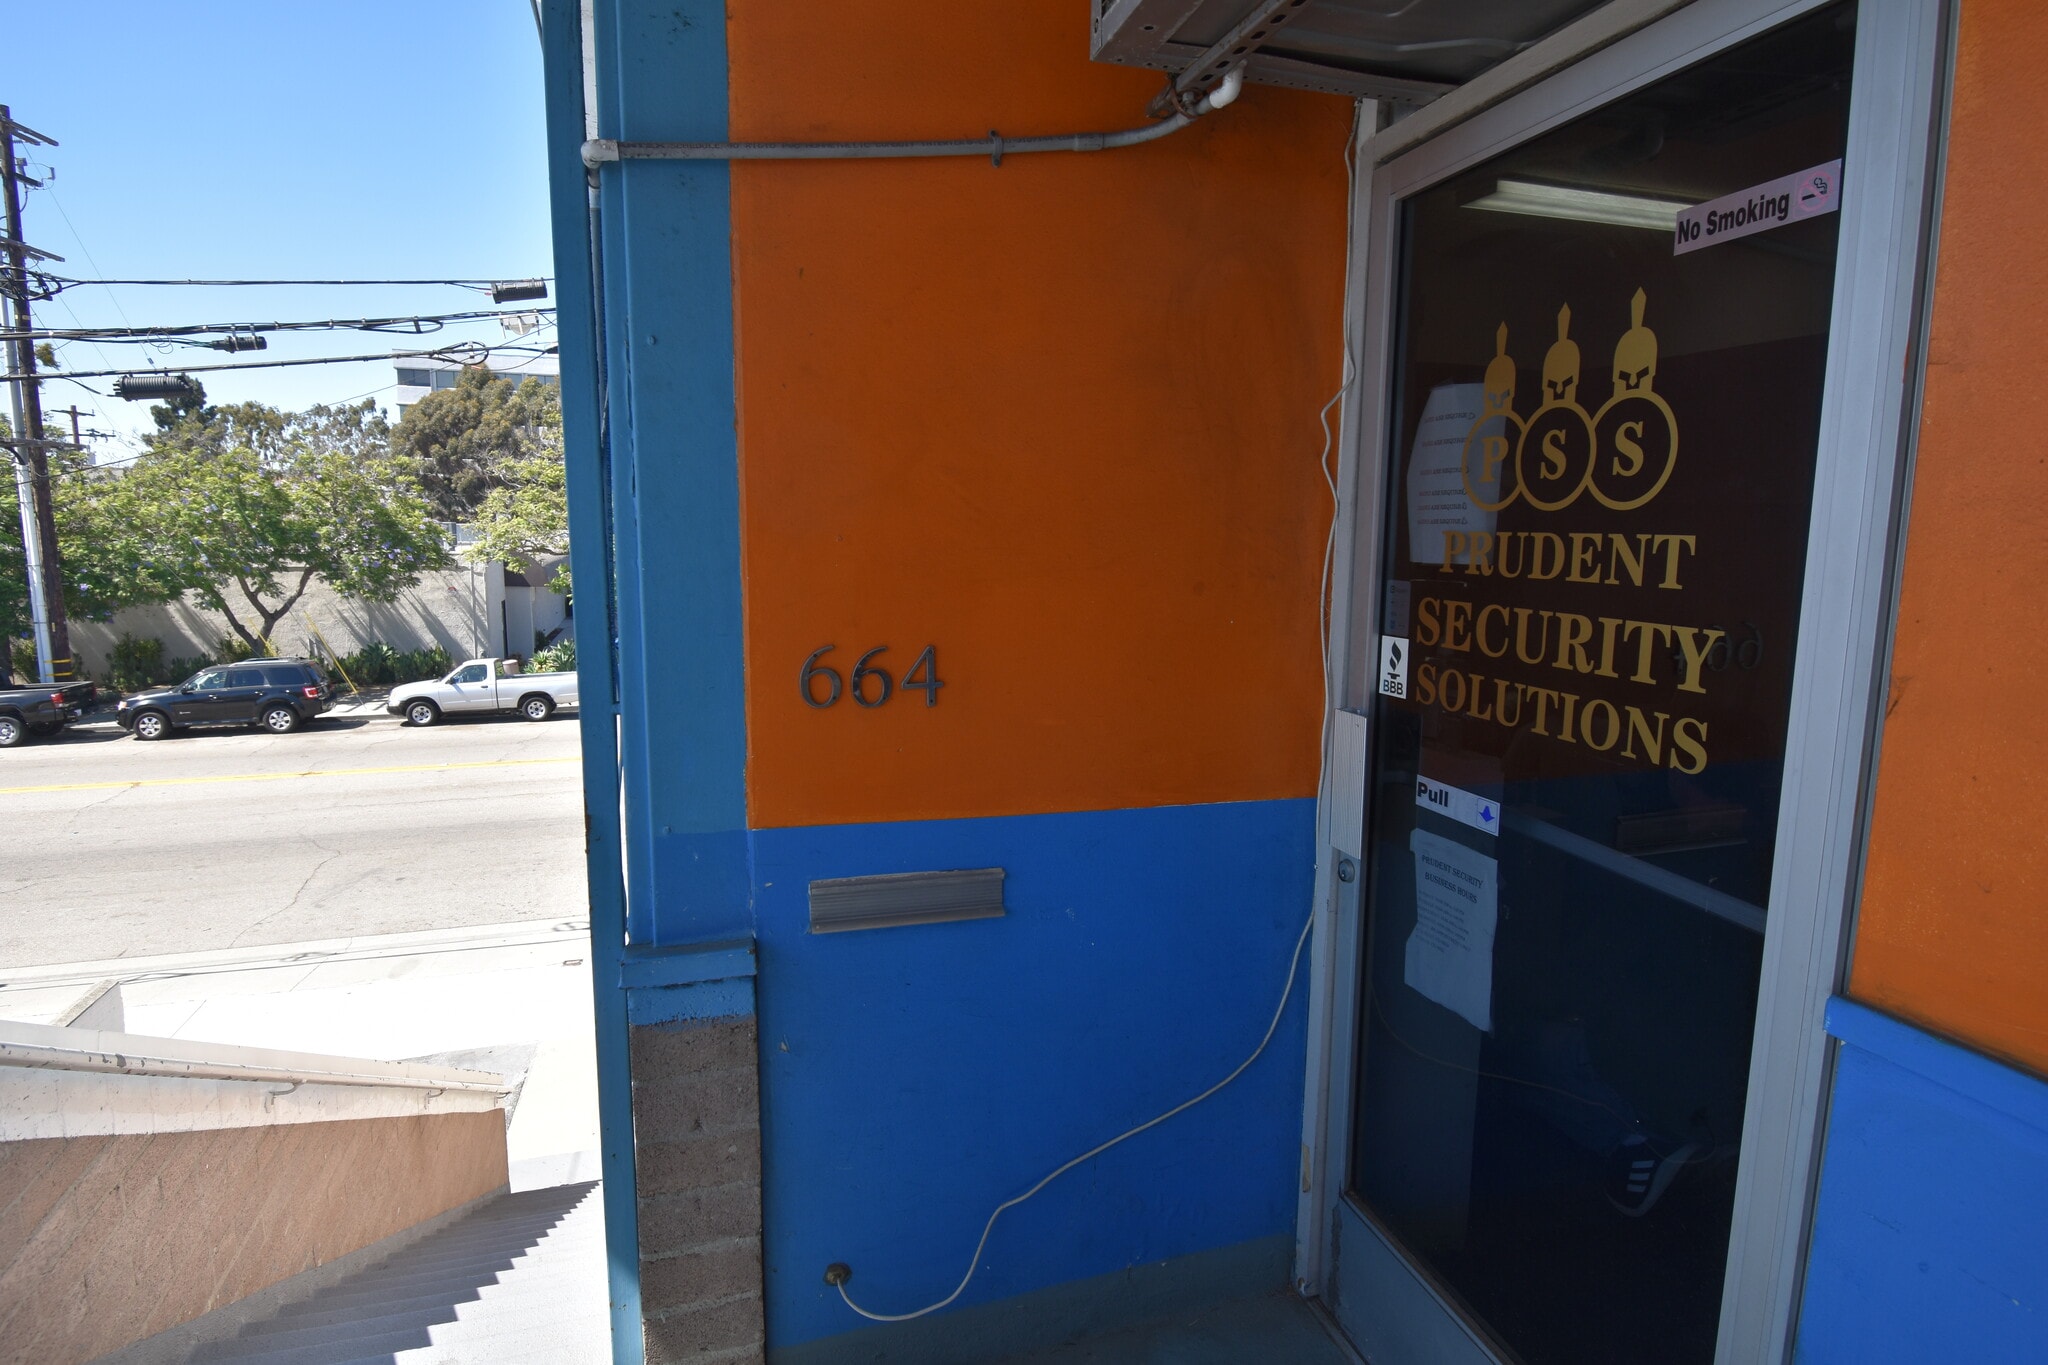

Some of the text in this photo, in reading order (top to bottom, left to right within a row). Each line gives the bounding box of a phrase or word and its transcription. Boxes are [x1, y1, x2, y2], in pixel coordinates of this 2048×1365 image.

[1677, 191, 1790, 246] No Smoking
[1440, 530, 1696, 590] PRUDENT
[1416, 596, 1725, 694] SECURITY
[798, 643, 944, 709] 664
[1383, 680, 1404, 695] BBB
[1416, 664, 1709, 775] SOLUTIONS
[1416, 782, 1449, 808] Pull
[1421, 854, 1484, 889] PRUDENT SECURITY
[1424, 871, 1478, 904] BUSINESS HOURS
